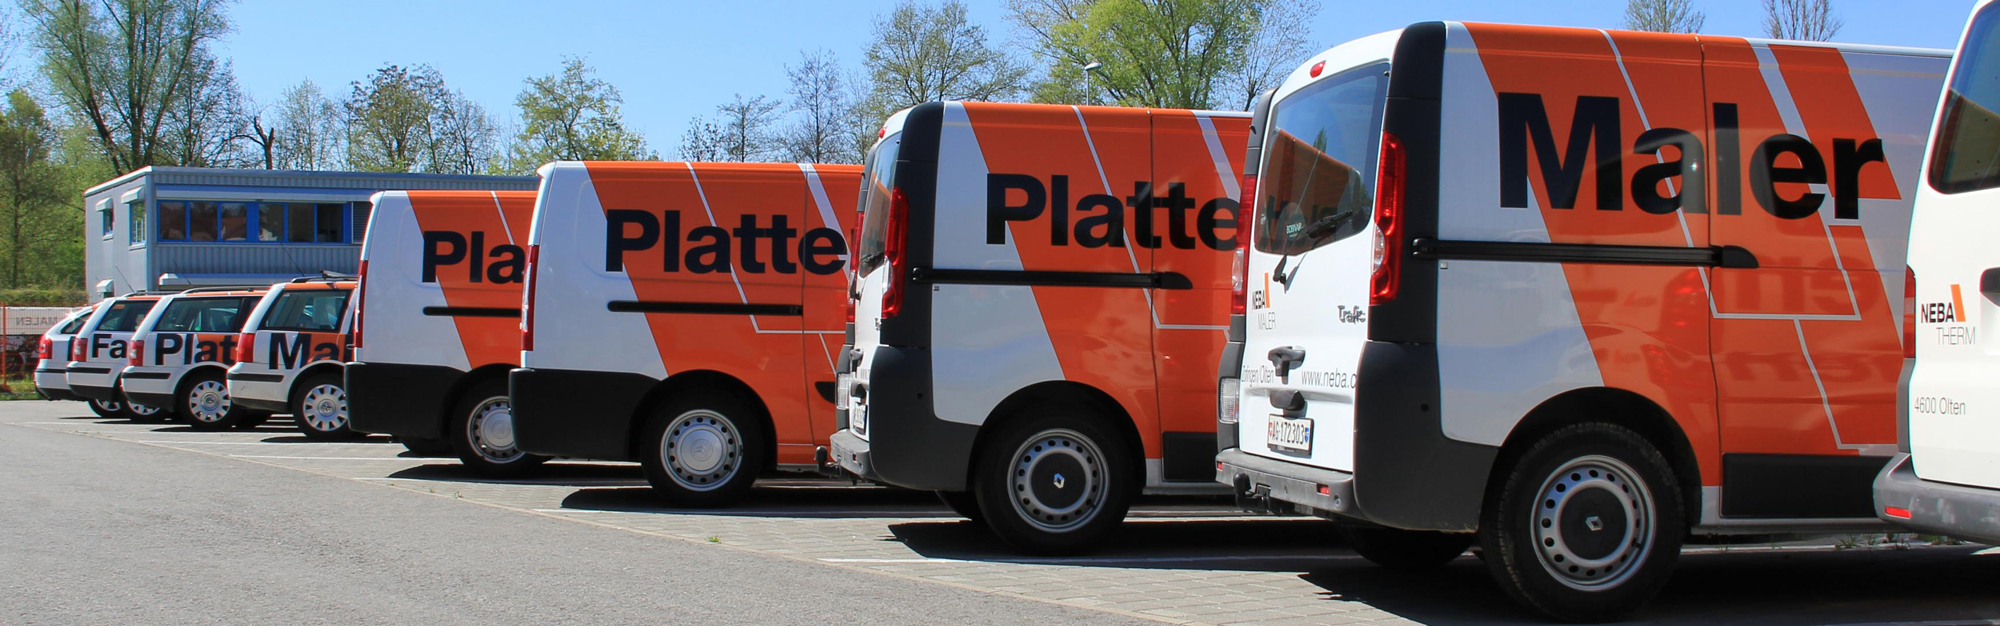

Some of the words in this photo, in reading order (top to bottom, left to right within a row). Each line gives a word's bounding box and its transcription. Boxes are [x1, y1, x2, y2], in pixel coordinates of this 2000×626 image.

[1498, 92, 1885, 220] Maler
[605, 209, 856, 275] Platte
[421, 231, 525, 285] Pla
[1252, 289, 1266, 310] NEBA
[1257, 311, 1277, 330] MALER
[1920, 302, 1955, 324] NEBA
[92, 333, 128, 359] Fa
[1936, 326, 1976, 345] THERM
[155, 333, 237, 368] Plat
[1914, 396, 1937, 414] 4600
[1939, 396, 1966, 416] Olten
